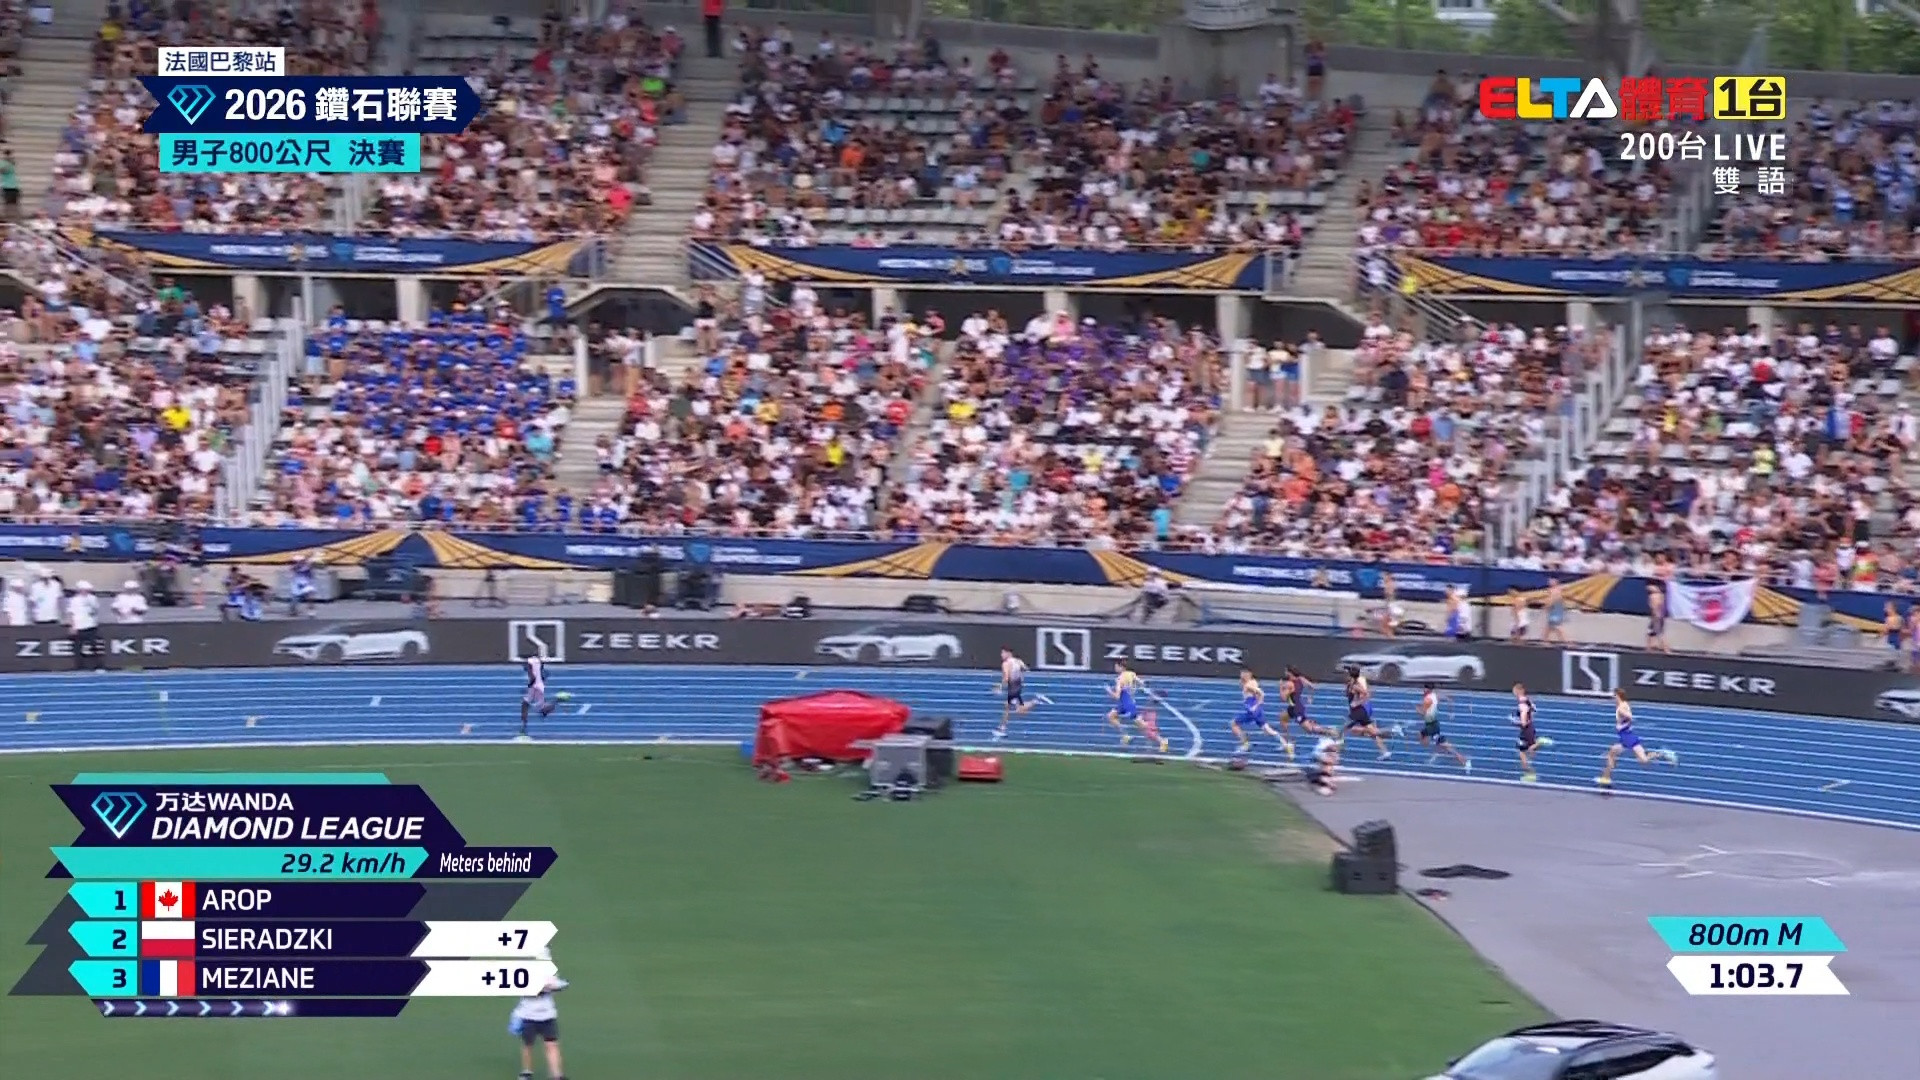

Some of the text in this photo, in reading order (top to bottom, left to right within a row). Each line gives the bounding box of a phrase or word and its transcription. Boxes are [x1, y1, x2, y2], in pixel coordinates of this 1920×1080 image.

[580, 632, 720, 649] ZEEKR
[1104, 643, 1244, 664] ZEEKR
[1632, 668, 1776, 696] ZEEKR
